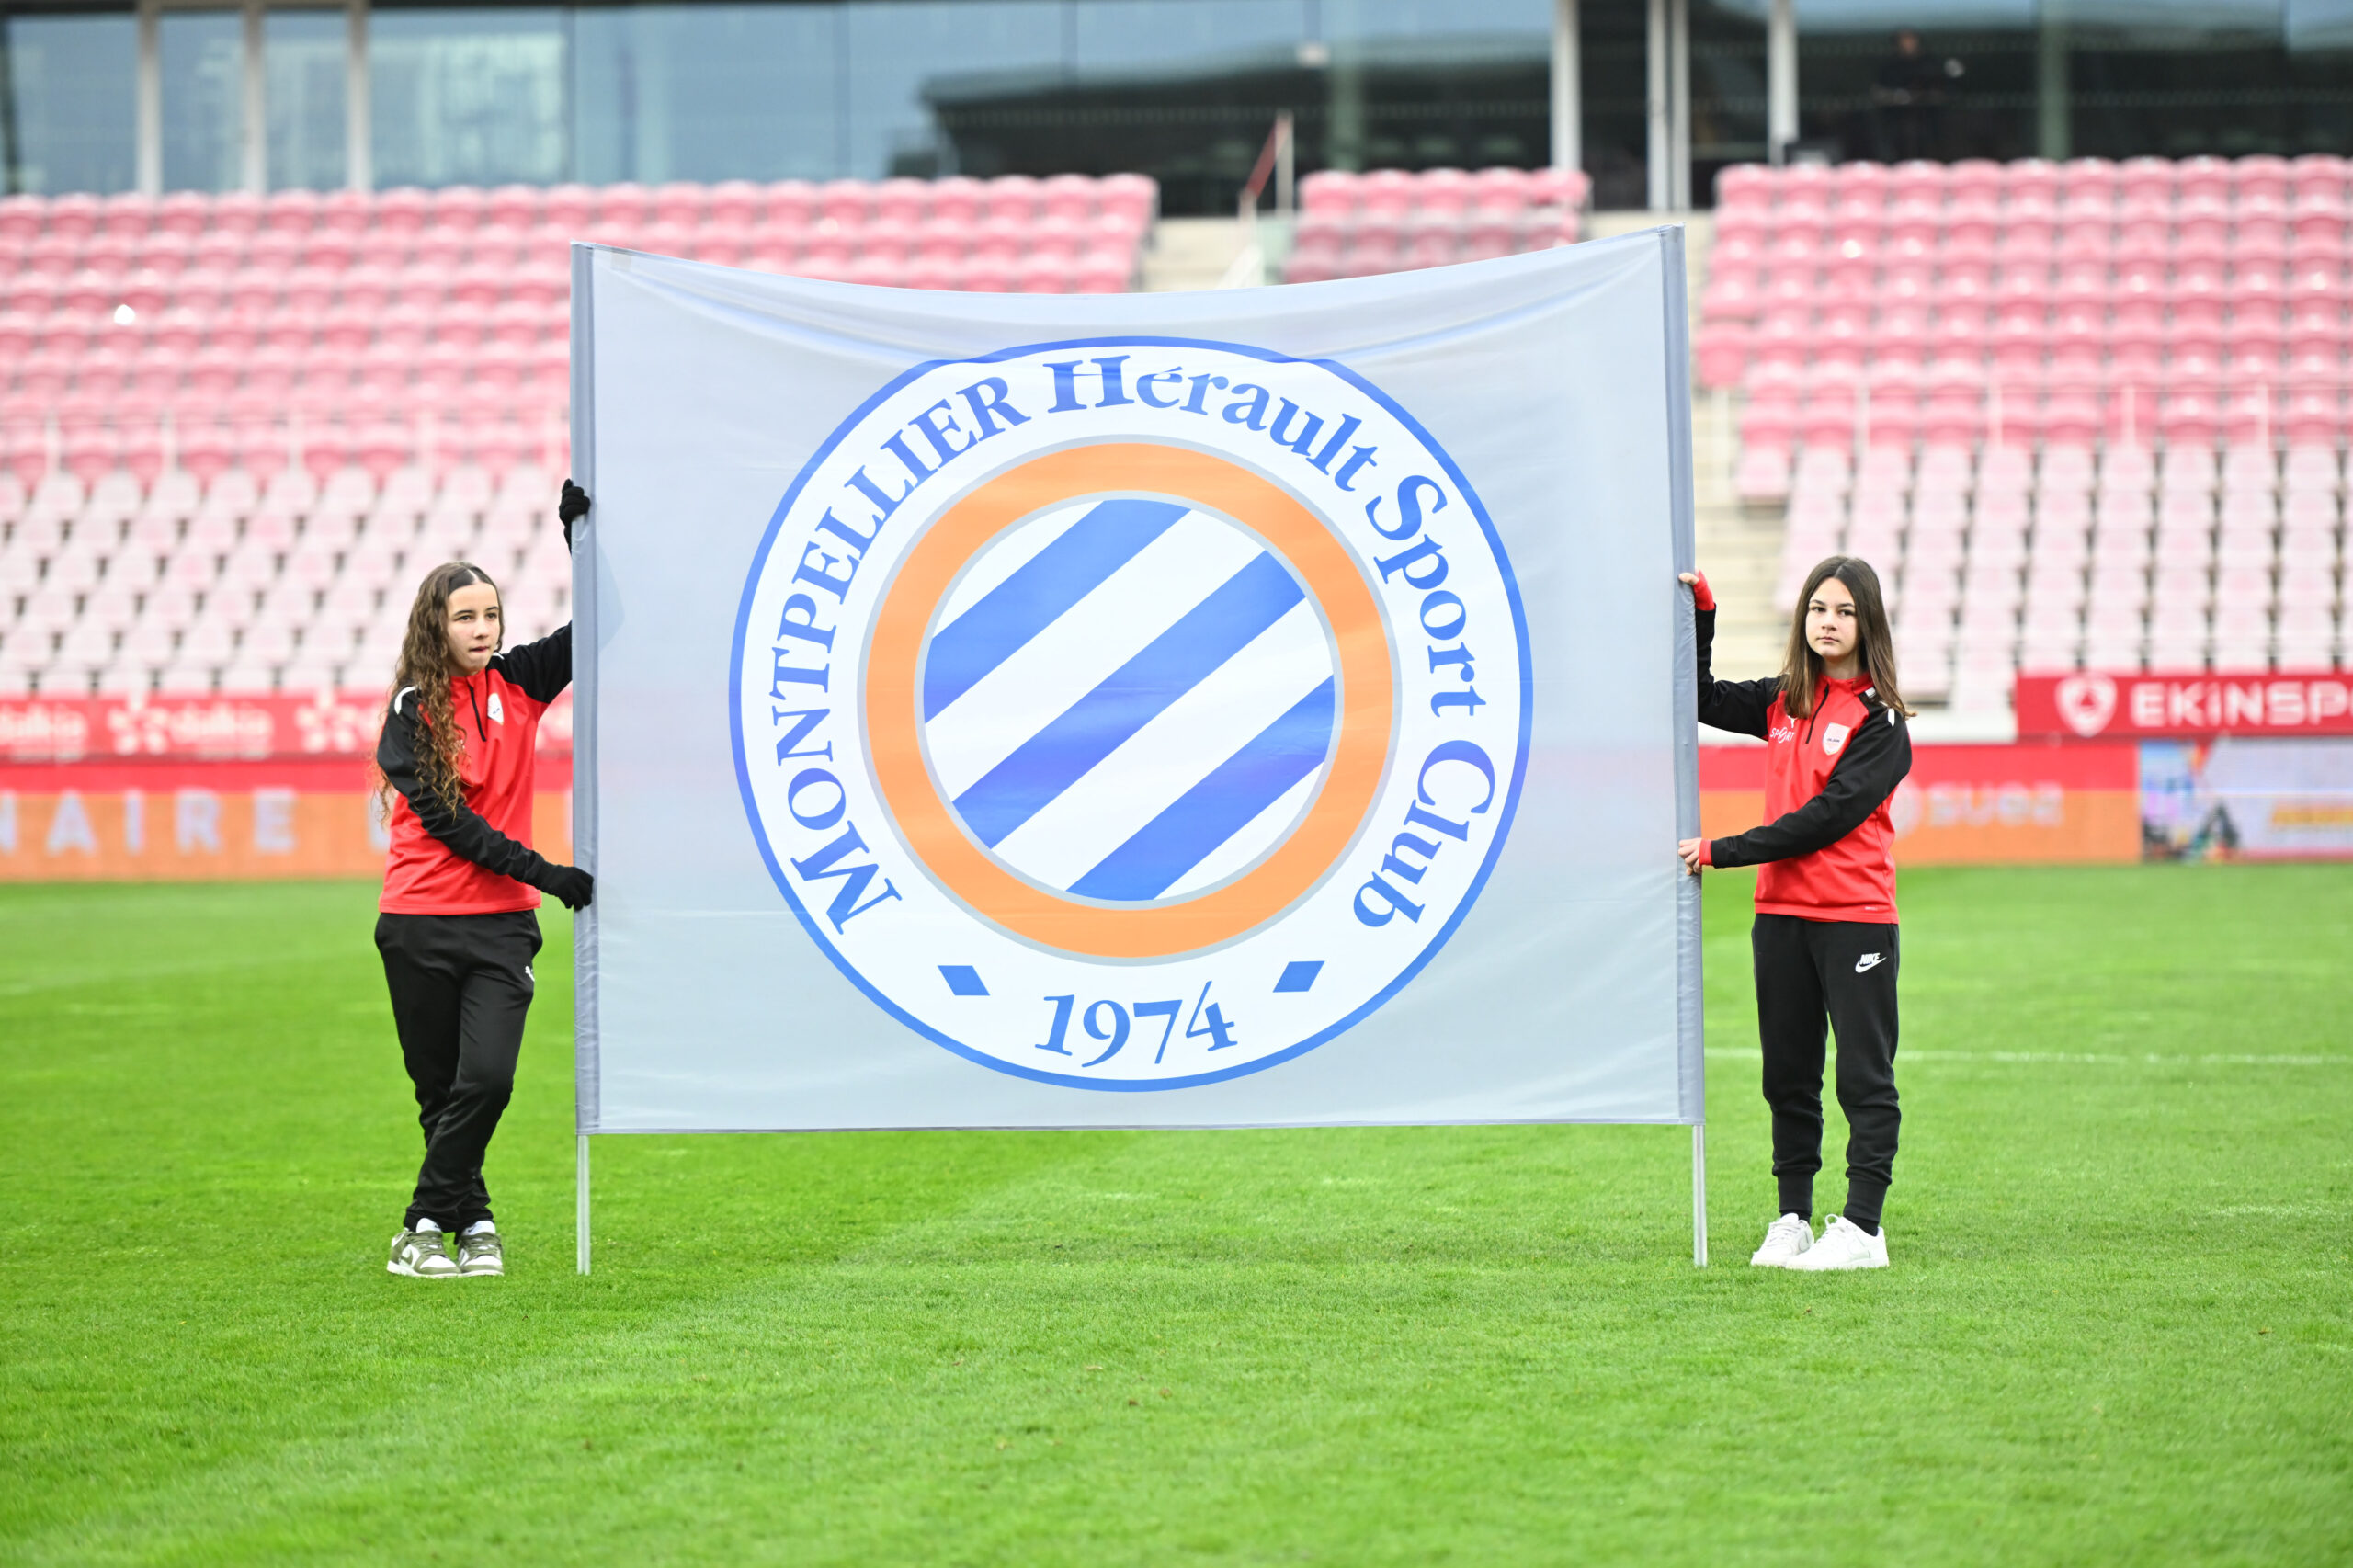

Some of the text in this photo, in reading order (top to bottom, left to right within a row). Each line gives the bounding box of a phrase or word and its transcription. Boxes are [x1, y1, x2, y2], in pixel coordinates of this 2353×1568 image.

[769, 355, 1495, 935] MONTPELLIER Hérault Sport Club
[2131, 681, 2353, 727] EKINSP
[1859, 952, 1881, 965] NIKE
[1035, 981, 1238, 1068] 1974
